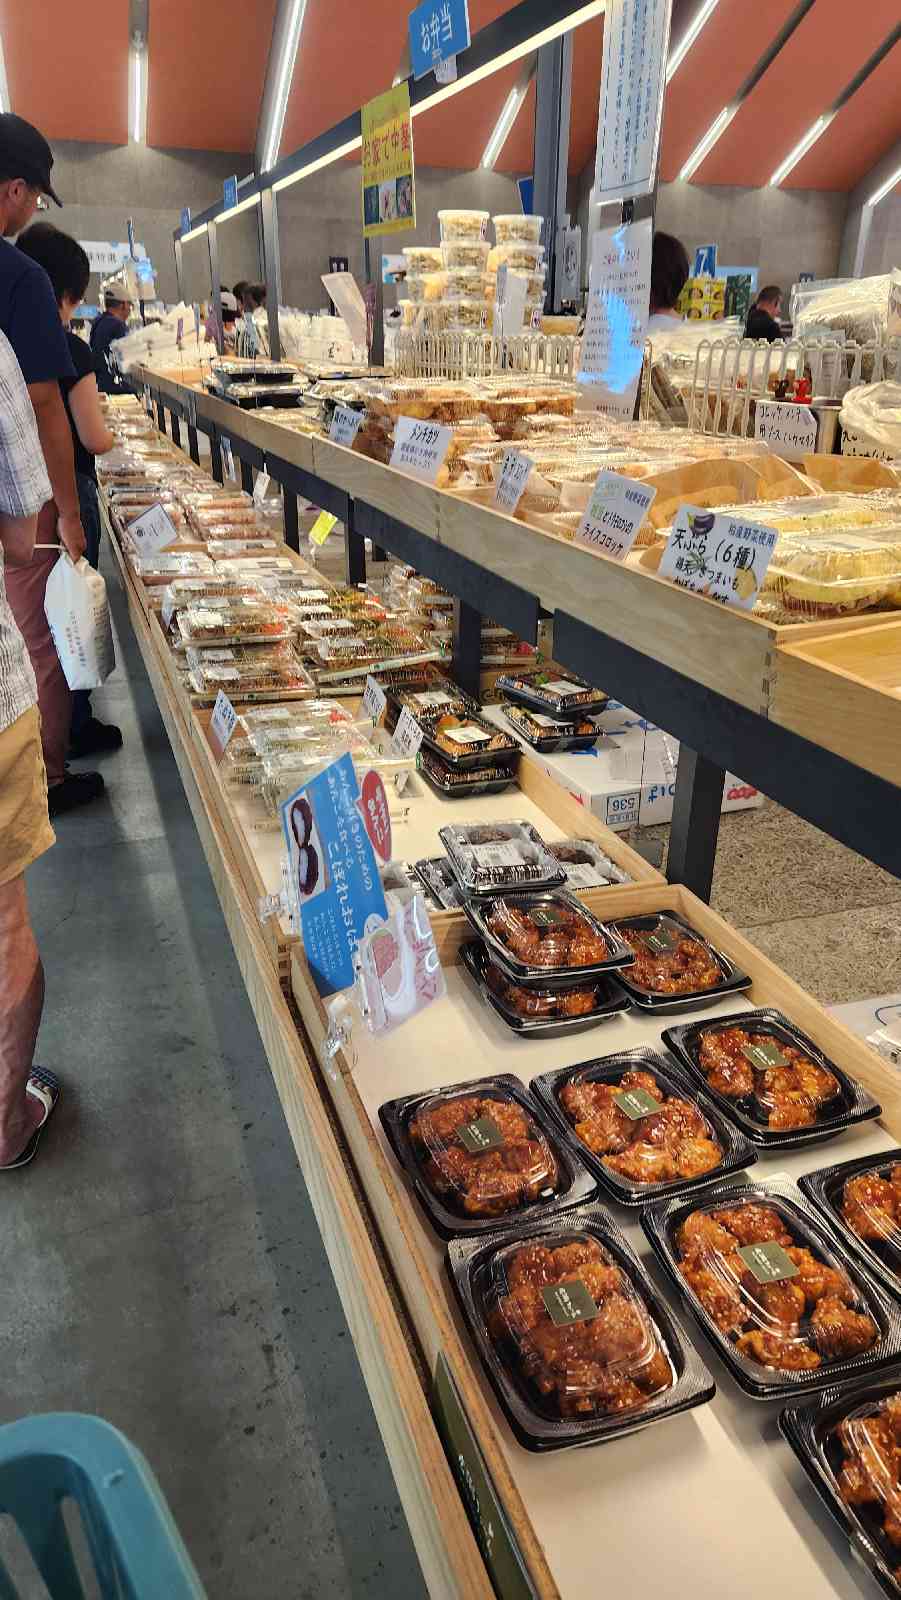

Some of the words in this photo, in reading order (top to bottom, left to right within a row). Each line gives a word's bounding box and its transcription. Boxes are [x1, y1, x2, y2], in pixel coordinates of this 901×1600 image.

[421, 1, 453, 55] お弁当
[612, 797, 635, 812] 536
